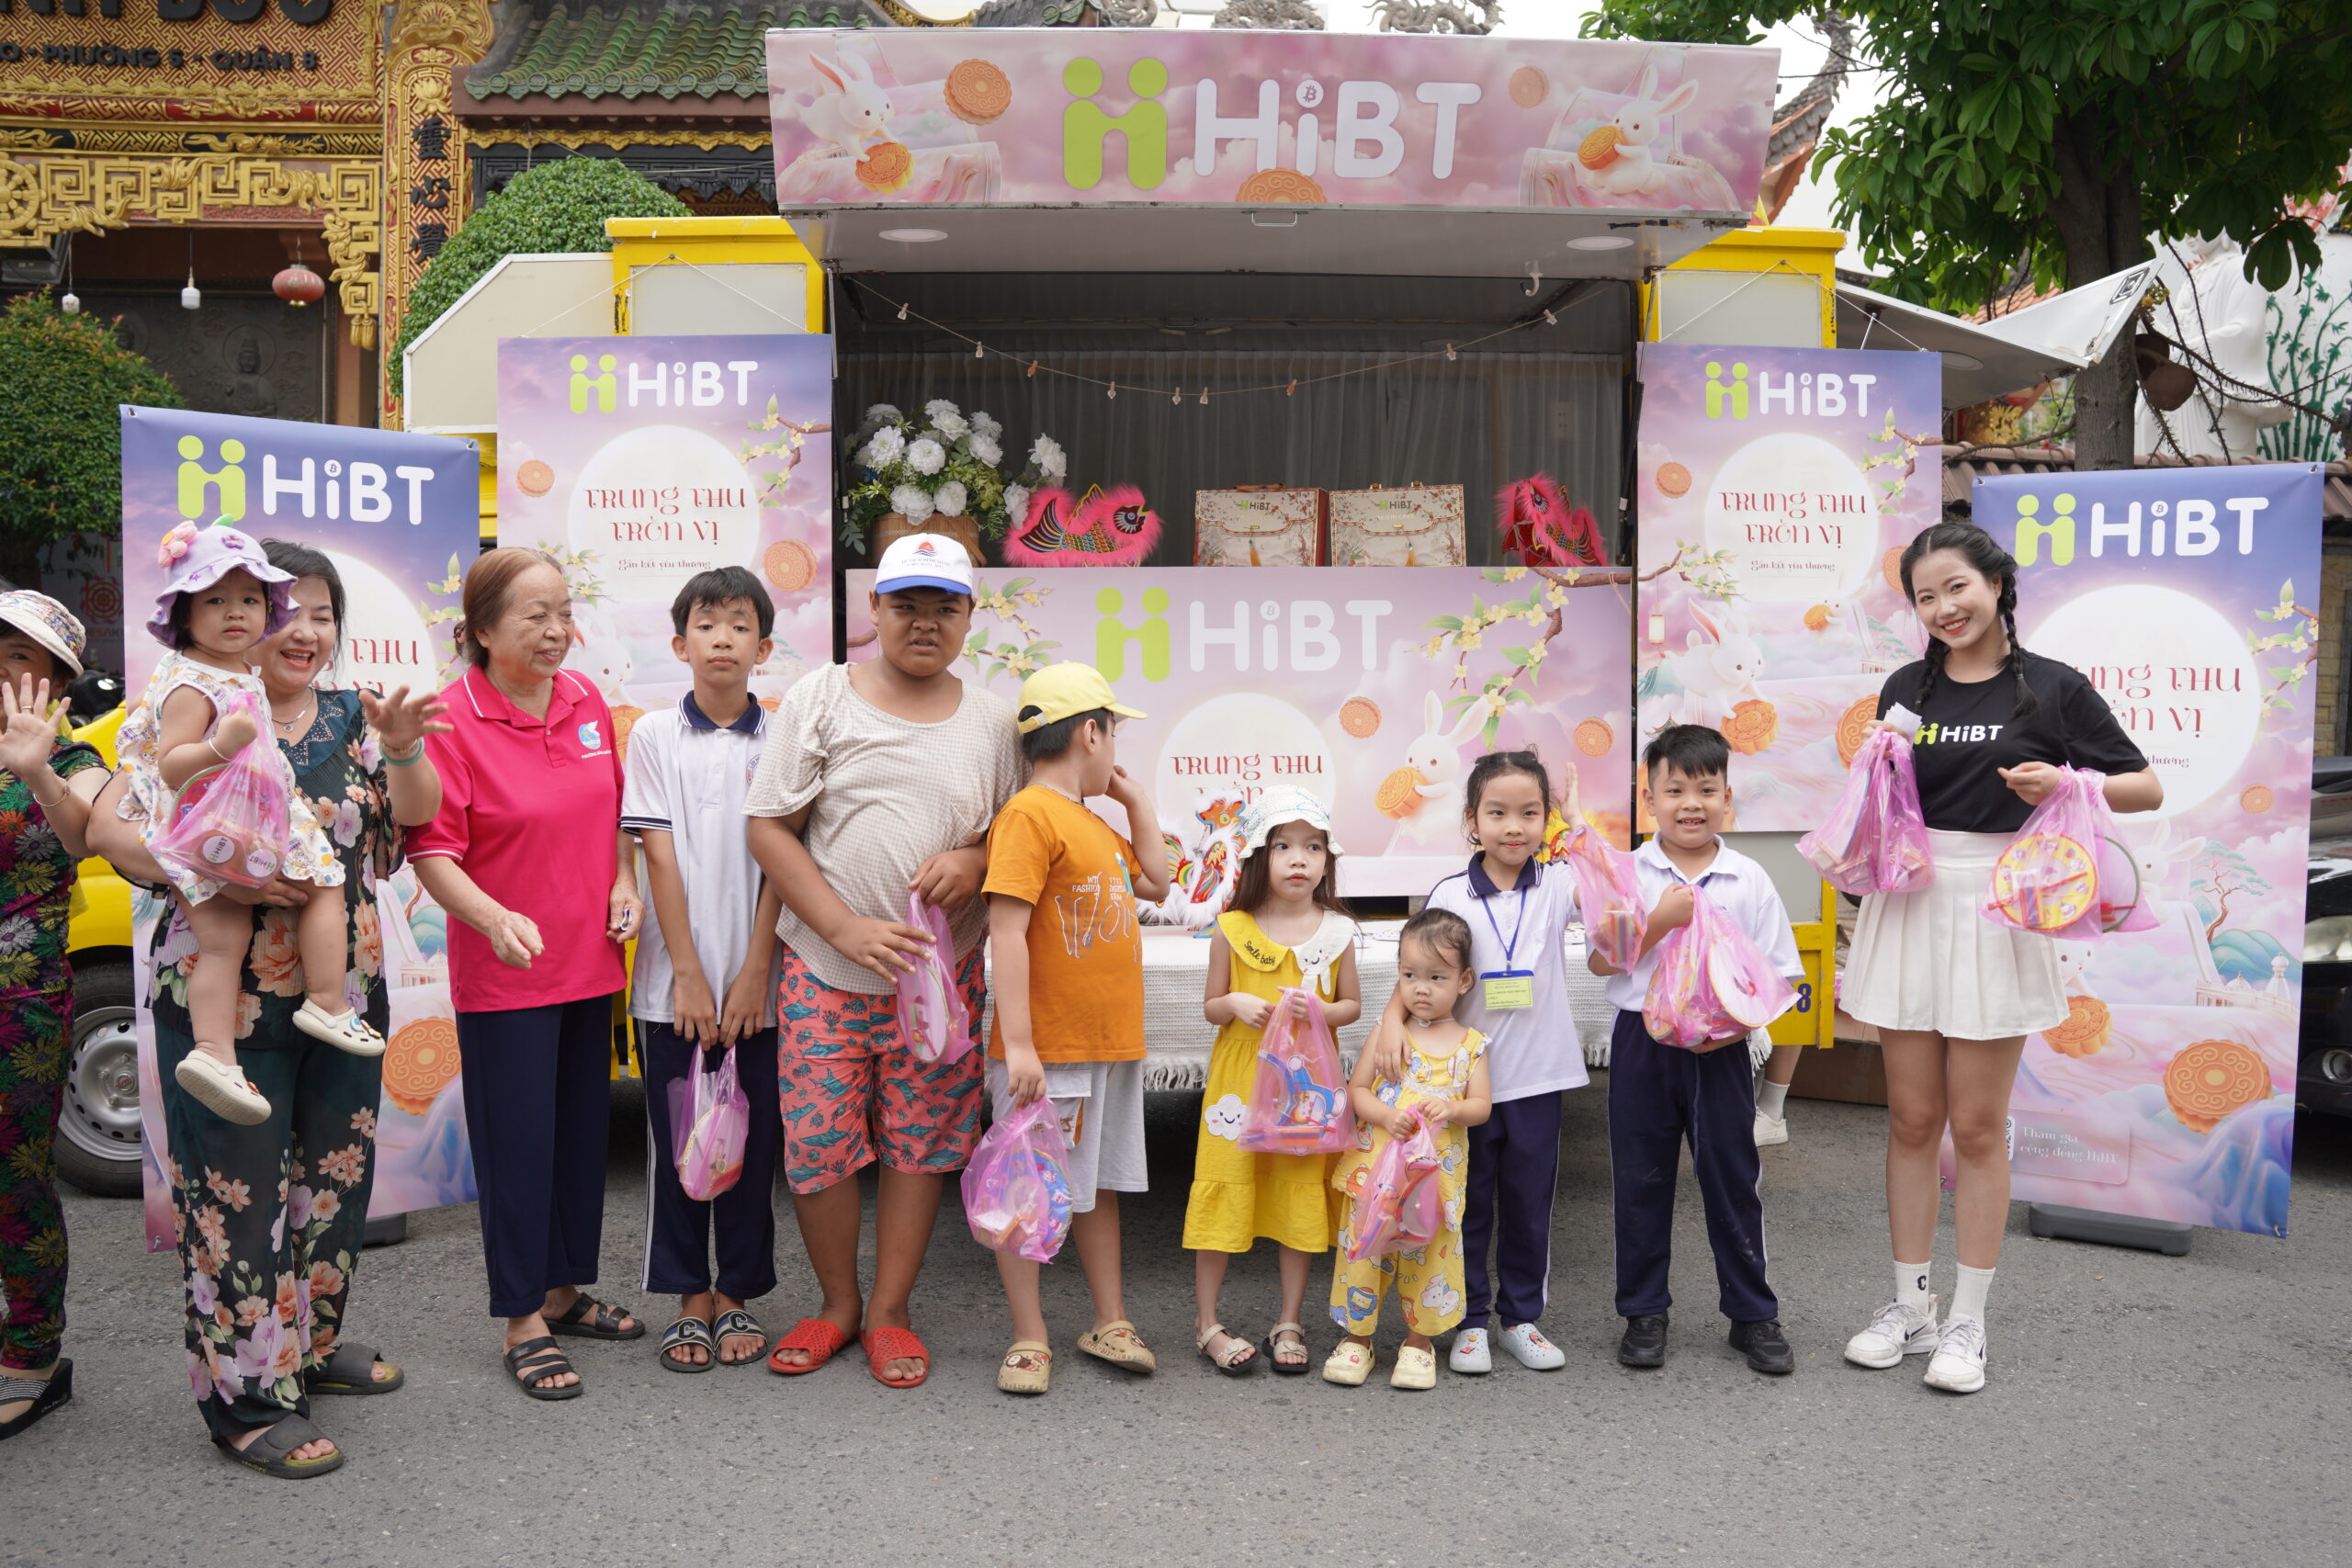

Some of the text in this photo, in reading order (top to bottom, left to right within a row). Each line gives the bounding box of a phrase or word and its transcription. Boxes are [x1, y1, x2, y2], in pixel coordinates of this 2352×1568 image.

[168, 48, 185, 67] 5
[210, 46, 293, 73] QUẬN
[302, 51, 318, 70] 8
[1194, 78, 1482, 179] HiBT
[628, 360, 759, 407] HiBT
[1759, 371, 1877, 418] HiBT
[263, 454, 435, 525] HiBT
[691, 488, 746, 508] THU
[1816, 493, 1866, 513] THU
[693, 521, 720, 545] VỊ
[1819, 525, 1843, 549] VỊ
[2090, 497, 2269, 558] HiBT
[1189, 600, 1393, 671] HiBT
[348, 638, 419, 665] THU
[2164, 667, 2242, 693] THU
[1940, 725, 2004, 743] HiBT
[2168, 706, 2206, 739] VỊ
[1270, 754, 1323, 774] THU
[1917, 1275, 1927, 1291] C
[676, 1319, 697, 1339] C
[729, 1312, 749, 1332] C
